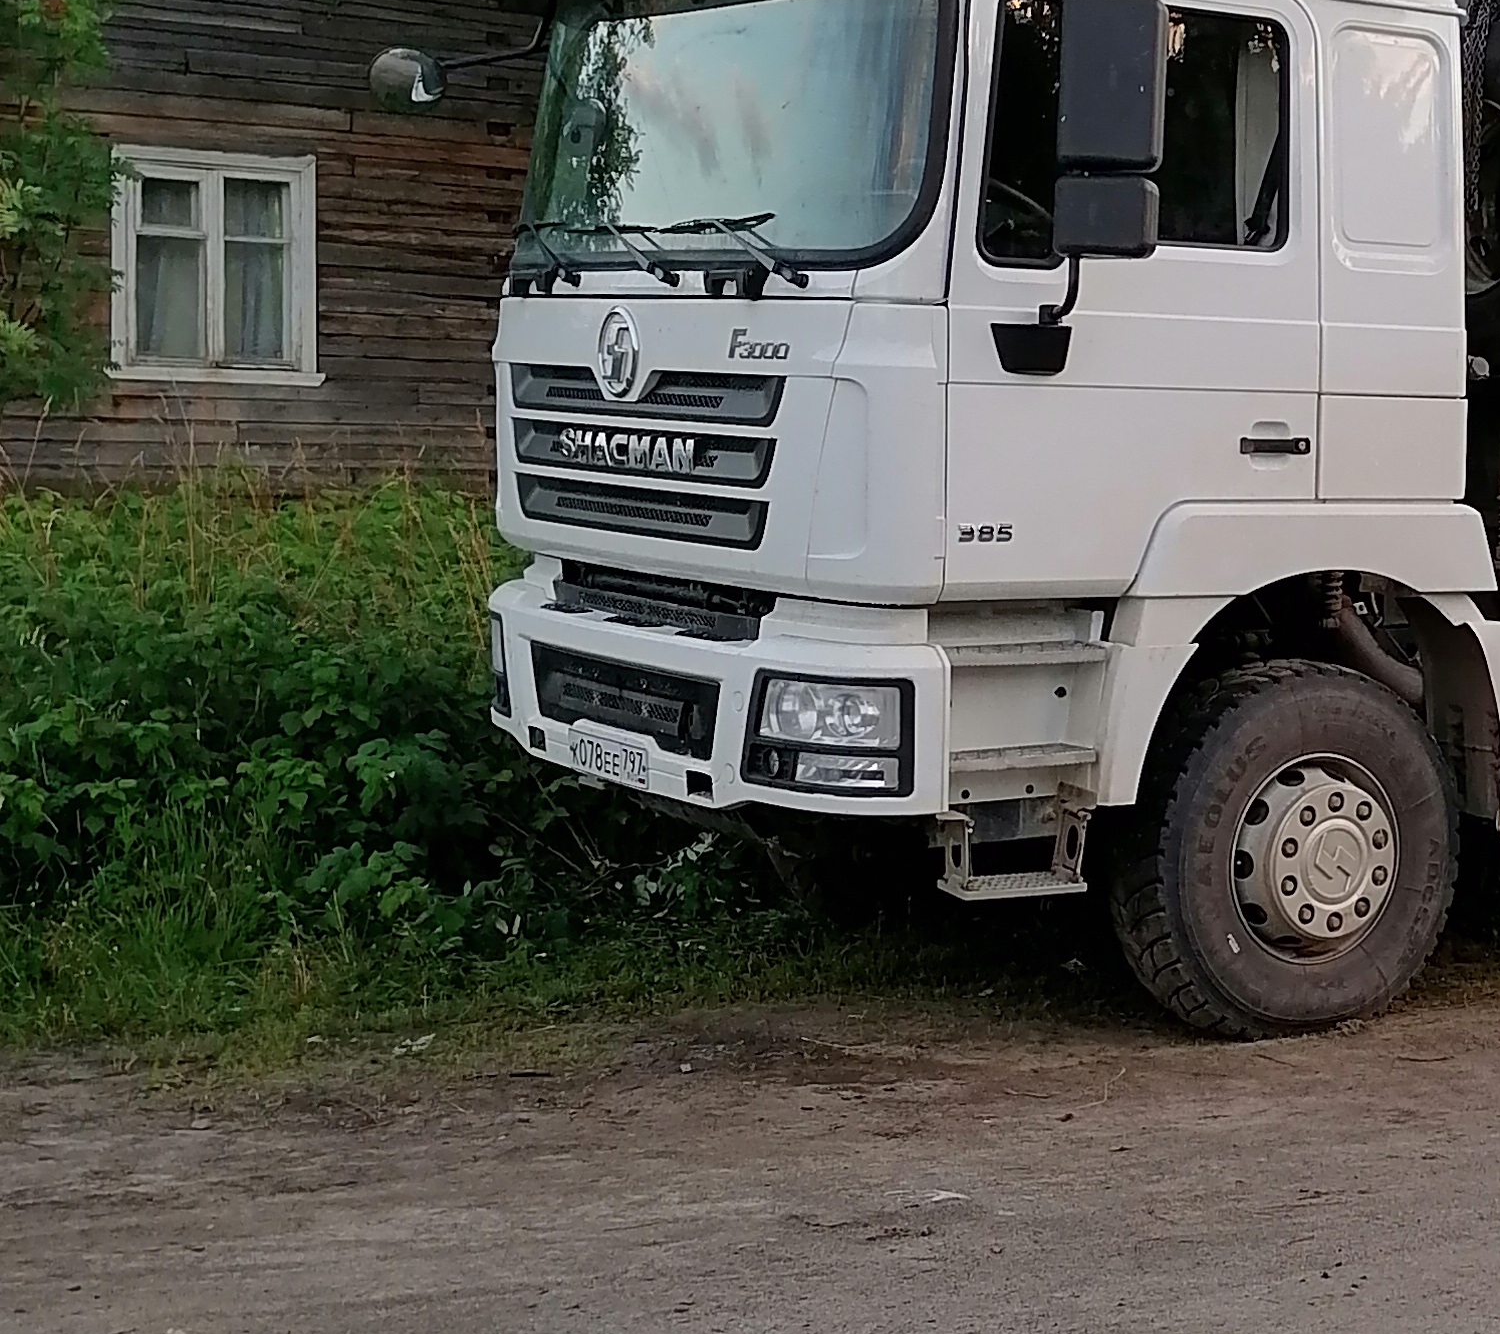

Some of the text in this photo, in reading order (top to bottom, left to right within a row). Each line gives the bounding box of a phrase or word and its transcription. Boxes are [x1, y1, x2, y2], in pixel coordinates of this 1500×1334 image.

[728, 328, 790, 360] F3000
[559, 427, 695, 474] SHACMAN
[958, 523, 1013, 542] 385
